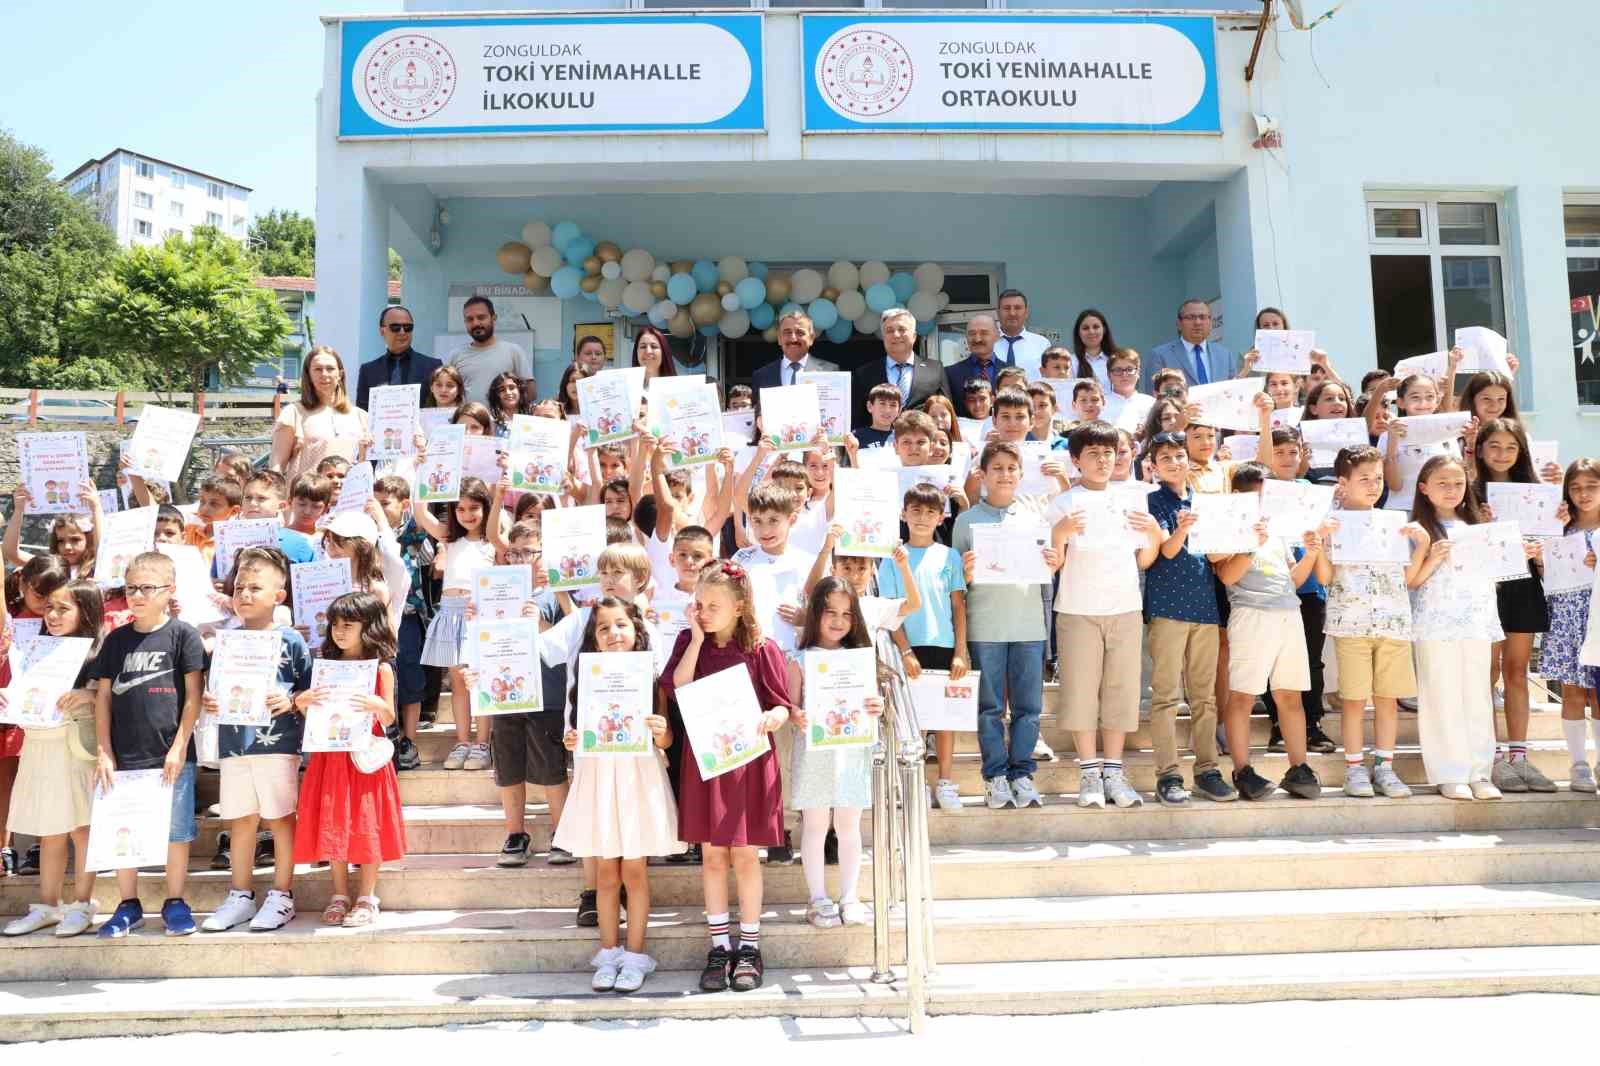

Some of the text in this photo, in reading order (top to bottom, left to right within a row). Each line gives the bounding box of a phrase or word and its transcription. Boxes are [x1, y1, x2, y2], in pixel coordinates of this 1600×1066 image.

[483, 43, 585, 59] ZONGULDAK
[939, 41, 1037, 55] ZONGULDAK
[483, 60, 702, 82] TOKİ YENİMAHALLE
[940, 58, 1153, 80] TOKİ YENİMAHALLE
[483, 90, 596, 111] İLKOKULU
[942, 90, 1078, 107] ORTAOKULU
[122, 651, 169, 673] NIKE
